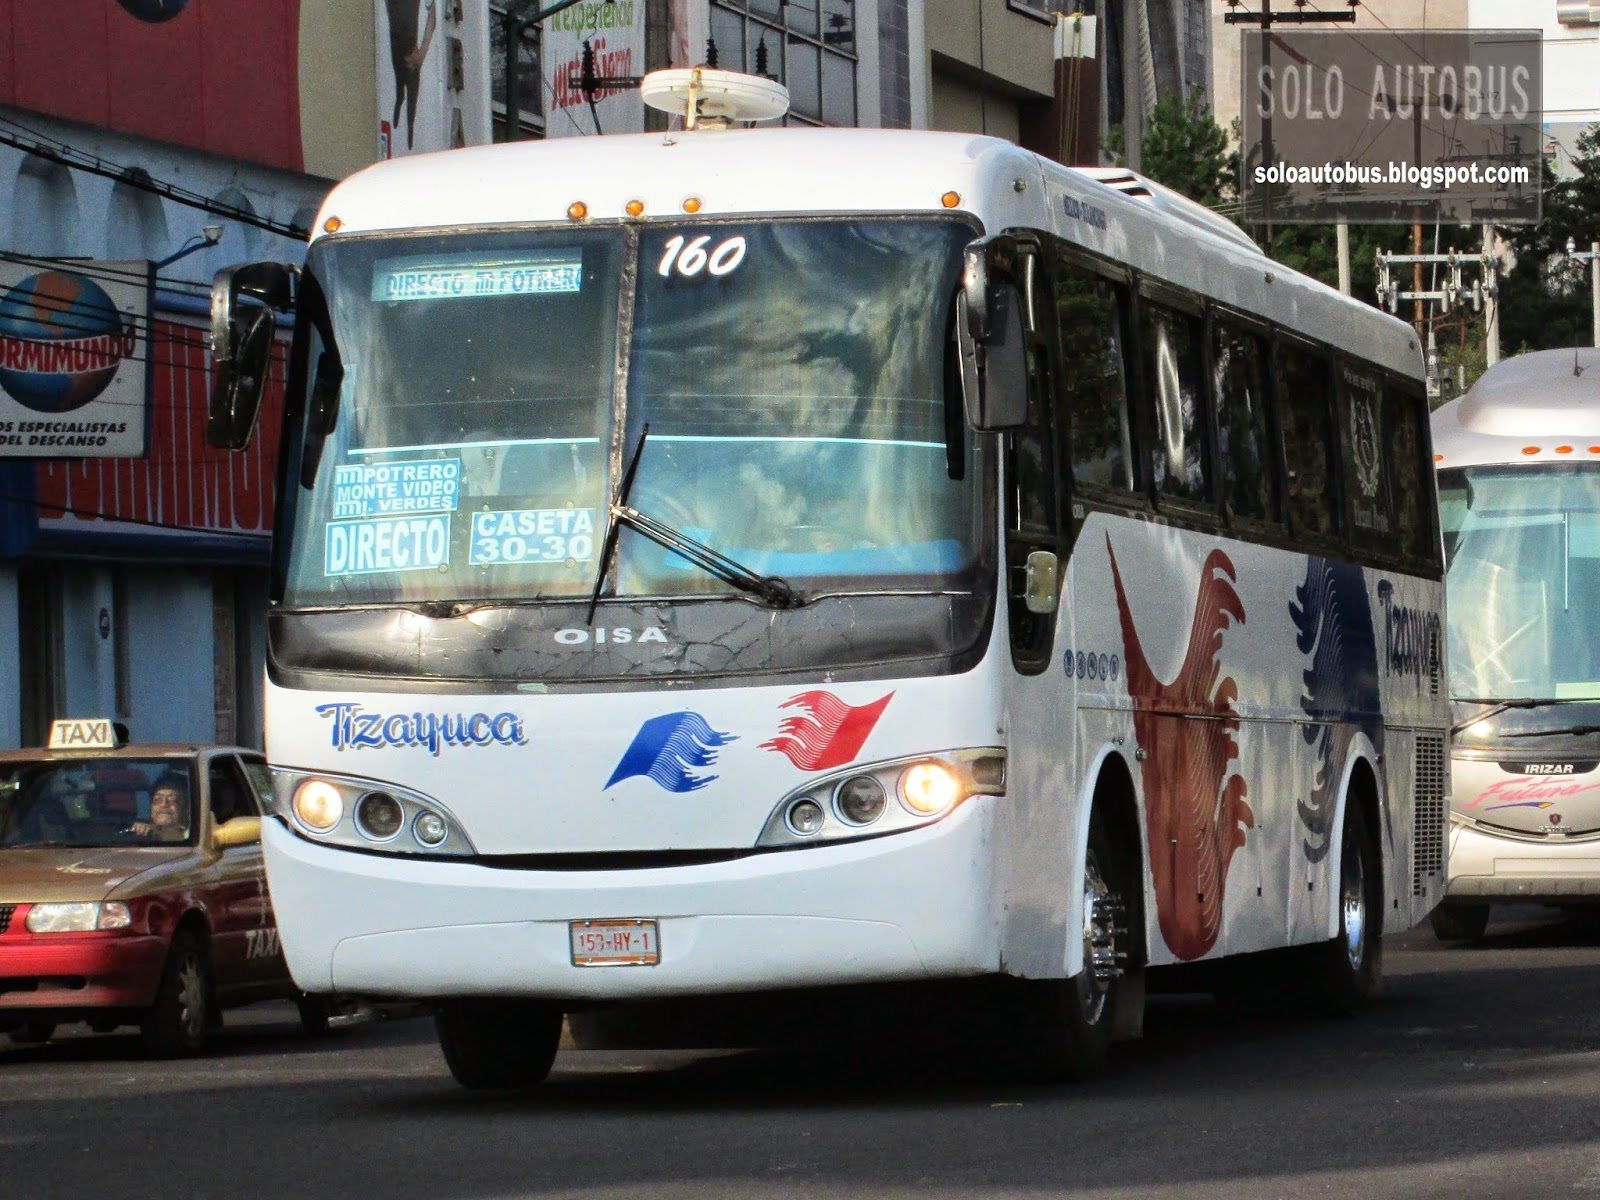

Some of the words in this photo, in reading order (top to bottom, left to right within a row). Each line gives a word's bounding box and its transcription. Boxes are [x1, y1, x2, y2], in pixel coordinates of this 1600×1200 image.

[658, 235, 746, 276] 160
[386, 271, 464, 297] DIRECTO
[18, 422, 127, 433] ESPECIALISTAS
[29, 435, 107, 446] DESCANSO
[364, 463, 458, 483] POTRERO
[337, 483, 398, 502] MONTE
[402, 480, 457, 497] VIDEO
[379, 495, 454, 511] VERDES
[477, 510, 593, 537] CASETA
[330, 517, 445, 572] DIRECTO
[475, 535, 593, 561] 30-30
[553, 626, 669, 644] OISA
[56, 722, 107, 745] TAXI
[315, 702, 527, 755] Tizayuca
[1524, 764, 1574, 774] IRIZAR
[1460, 777, 1600, 811] Futura
